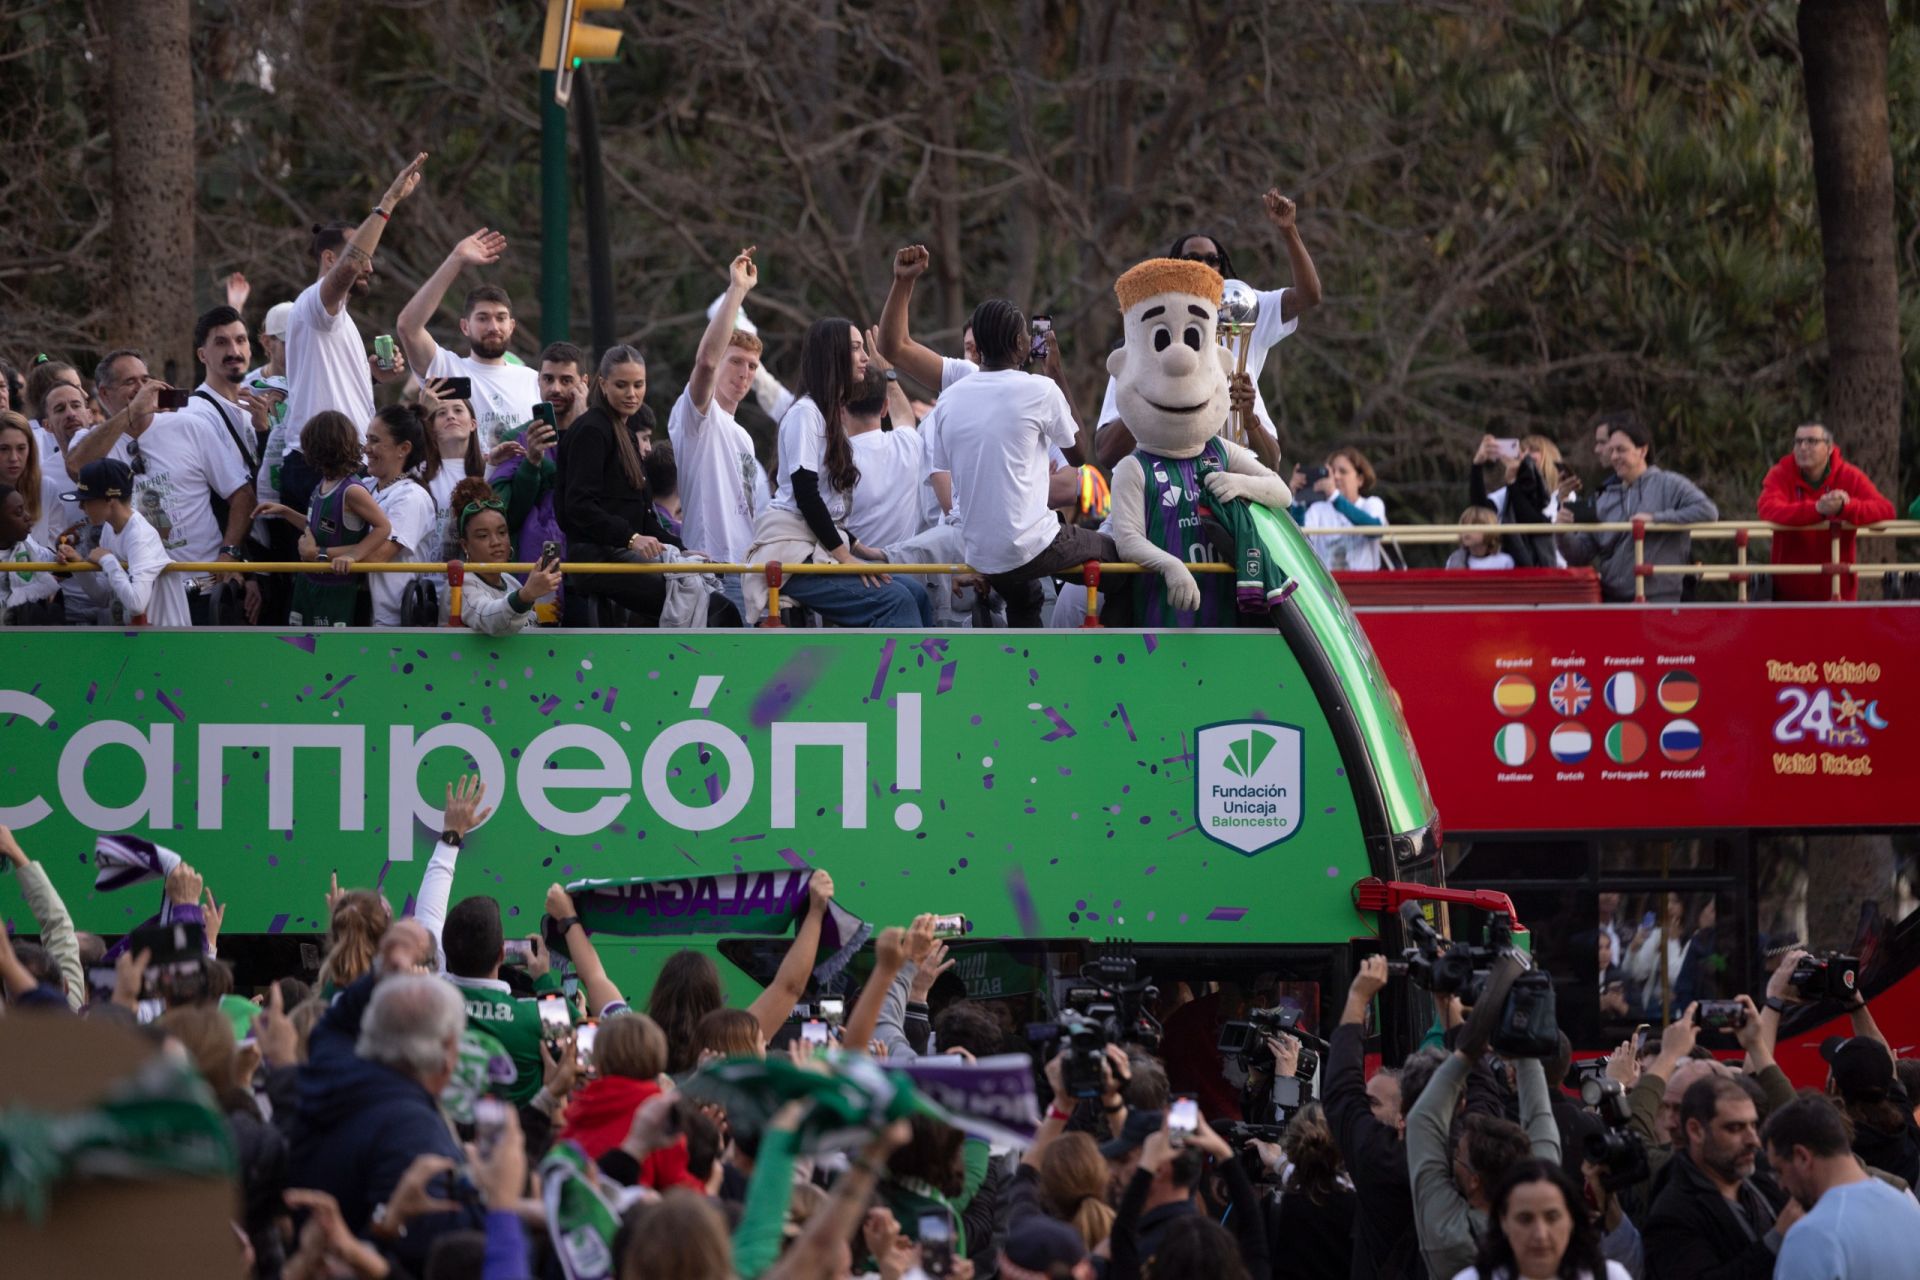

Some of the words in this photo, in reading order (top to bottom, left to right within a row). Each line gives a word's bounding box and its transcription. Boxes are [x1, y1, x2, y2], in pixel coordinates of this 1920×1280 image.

[1495, 657, 1533, 669] Español
[1551, 655, 1586, 669] English
[1604, 655, 1645, 668] Français
[1766, 659, 1819, 683] Ticket
[1822, 656, 1881, 684] Válido
[1774, 687, 1834, 742] 24
[1773, 752, 1817, 775] Valid
[1820, 752, 1873, 776] Ticket
[1497, 771, 1534, 783] Italiano
[1556, 770, 1585, 782] Dutch
[1601, 769, 1650, 782] Português
[1212, 784, 1287, 798] Fundación
[1223, 800, 1277, 817] Unicaja
[1211, 816, 1288, 828] Baloncesto
